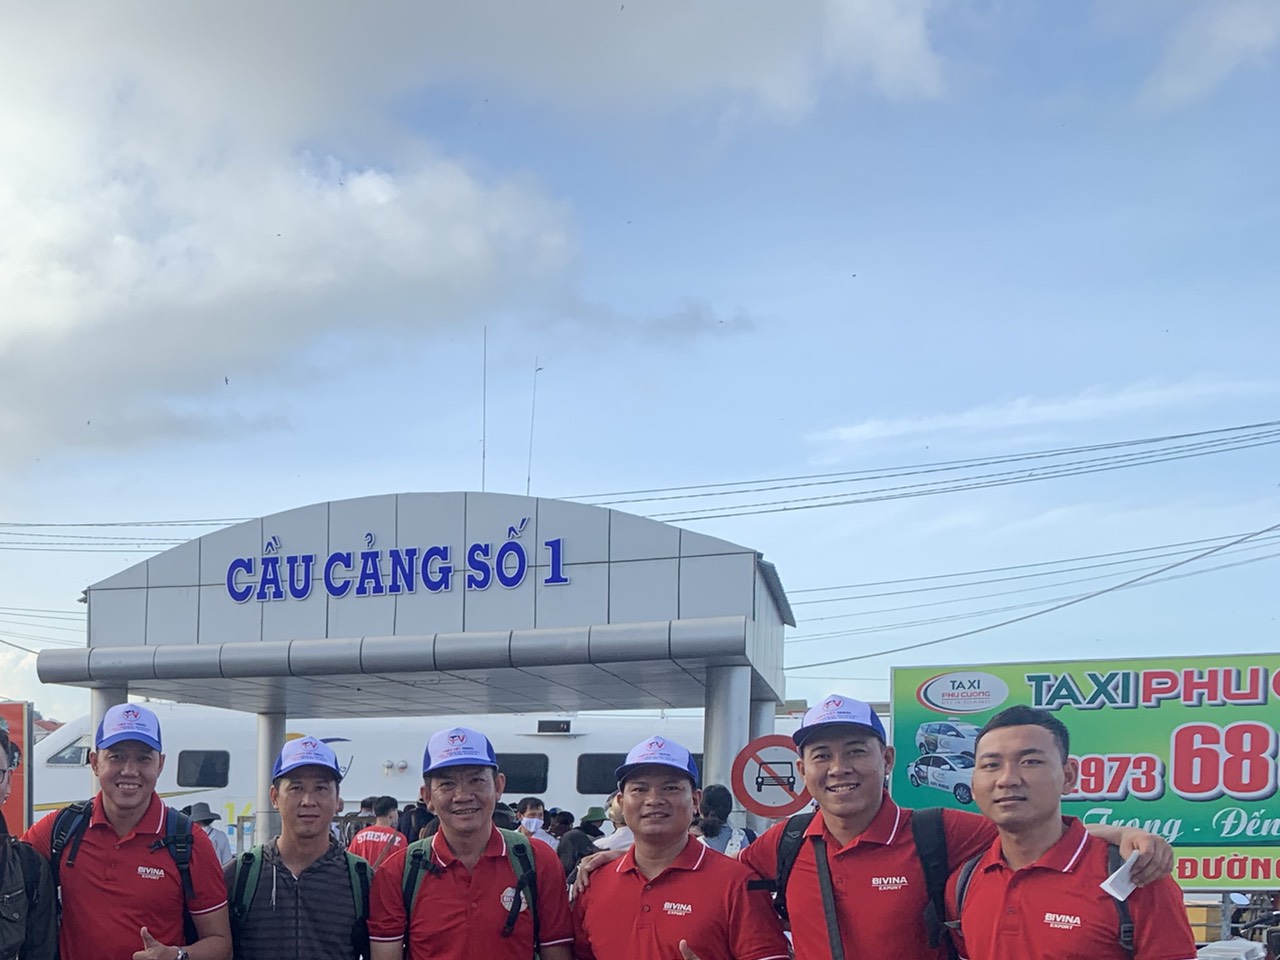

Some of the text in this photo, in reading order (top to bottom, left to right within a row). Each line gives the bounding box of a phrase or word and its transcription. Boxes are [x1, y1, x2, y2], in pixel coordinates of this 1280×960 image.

[226, 518, 570, 602] CẦU CẢNG SỐ 1
[950, 679, 980, 690] TAXI
[1027, 670, 1131, 707] TAXI
[1070, 724, 1270, 794] 973 68
[137, 865, 165, 876] BIVINA
[872, 876, 908, 885] BIVINA
[664, 902, 692, 911] BIVINA
[1044, 913, 1081, 925] BIVINA
